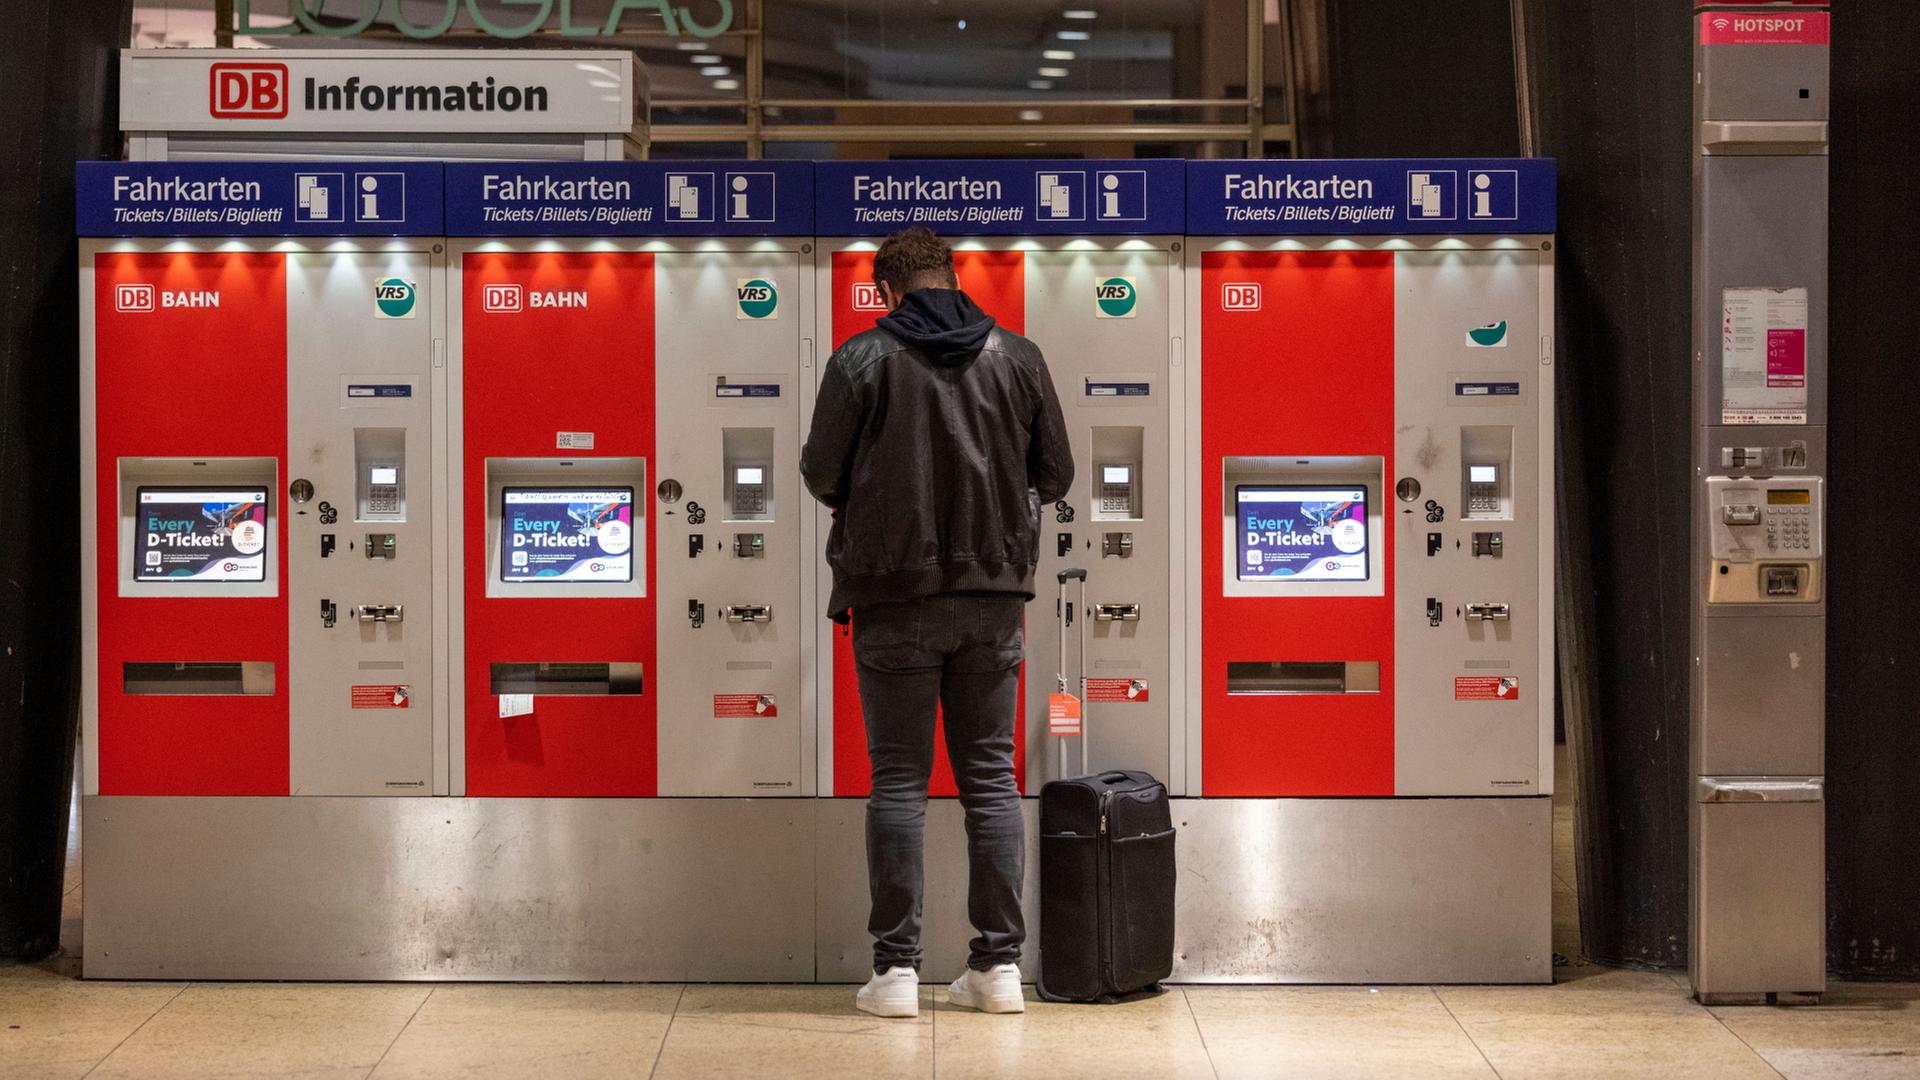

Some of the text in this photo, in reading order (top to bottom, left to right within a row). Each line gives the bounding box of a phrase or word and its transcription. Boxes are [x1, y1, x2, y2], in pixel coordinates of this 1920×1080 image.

[1734, 19, 1804, 32] HOTSPOT
[219, 72, 548, 112] DB Information
[114, 176, 261, 201] Fahrkarten
[483, 175, 631, 200] Fahrkarten
[854, 175, 1001, 200] Fahrkarten
[1225, 174, 1373, 199] Fahrkarten
[161, 291, 220, 307] BAHN
[375, 286, 405, 299] VRS
[529, 291, 588, 307] BAHN
[737, 287, 767, 300] VRS
[1096, 286, 1126, 299] VRS
[148, 517, 195, 533] Every
[513, 518, 560, 534] Every
[1247, 516, 1294, 532] Every
[147, 532, 224, 546] D-Ticket!
[513, 532, 590, 547] D-Ticket!
[1247, 531, 1325, 545] D-Ticket!
